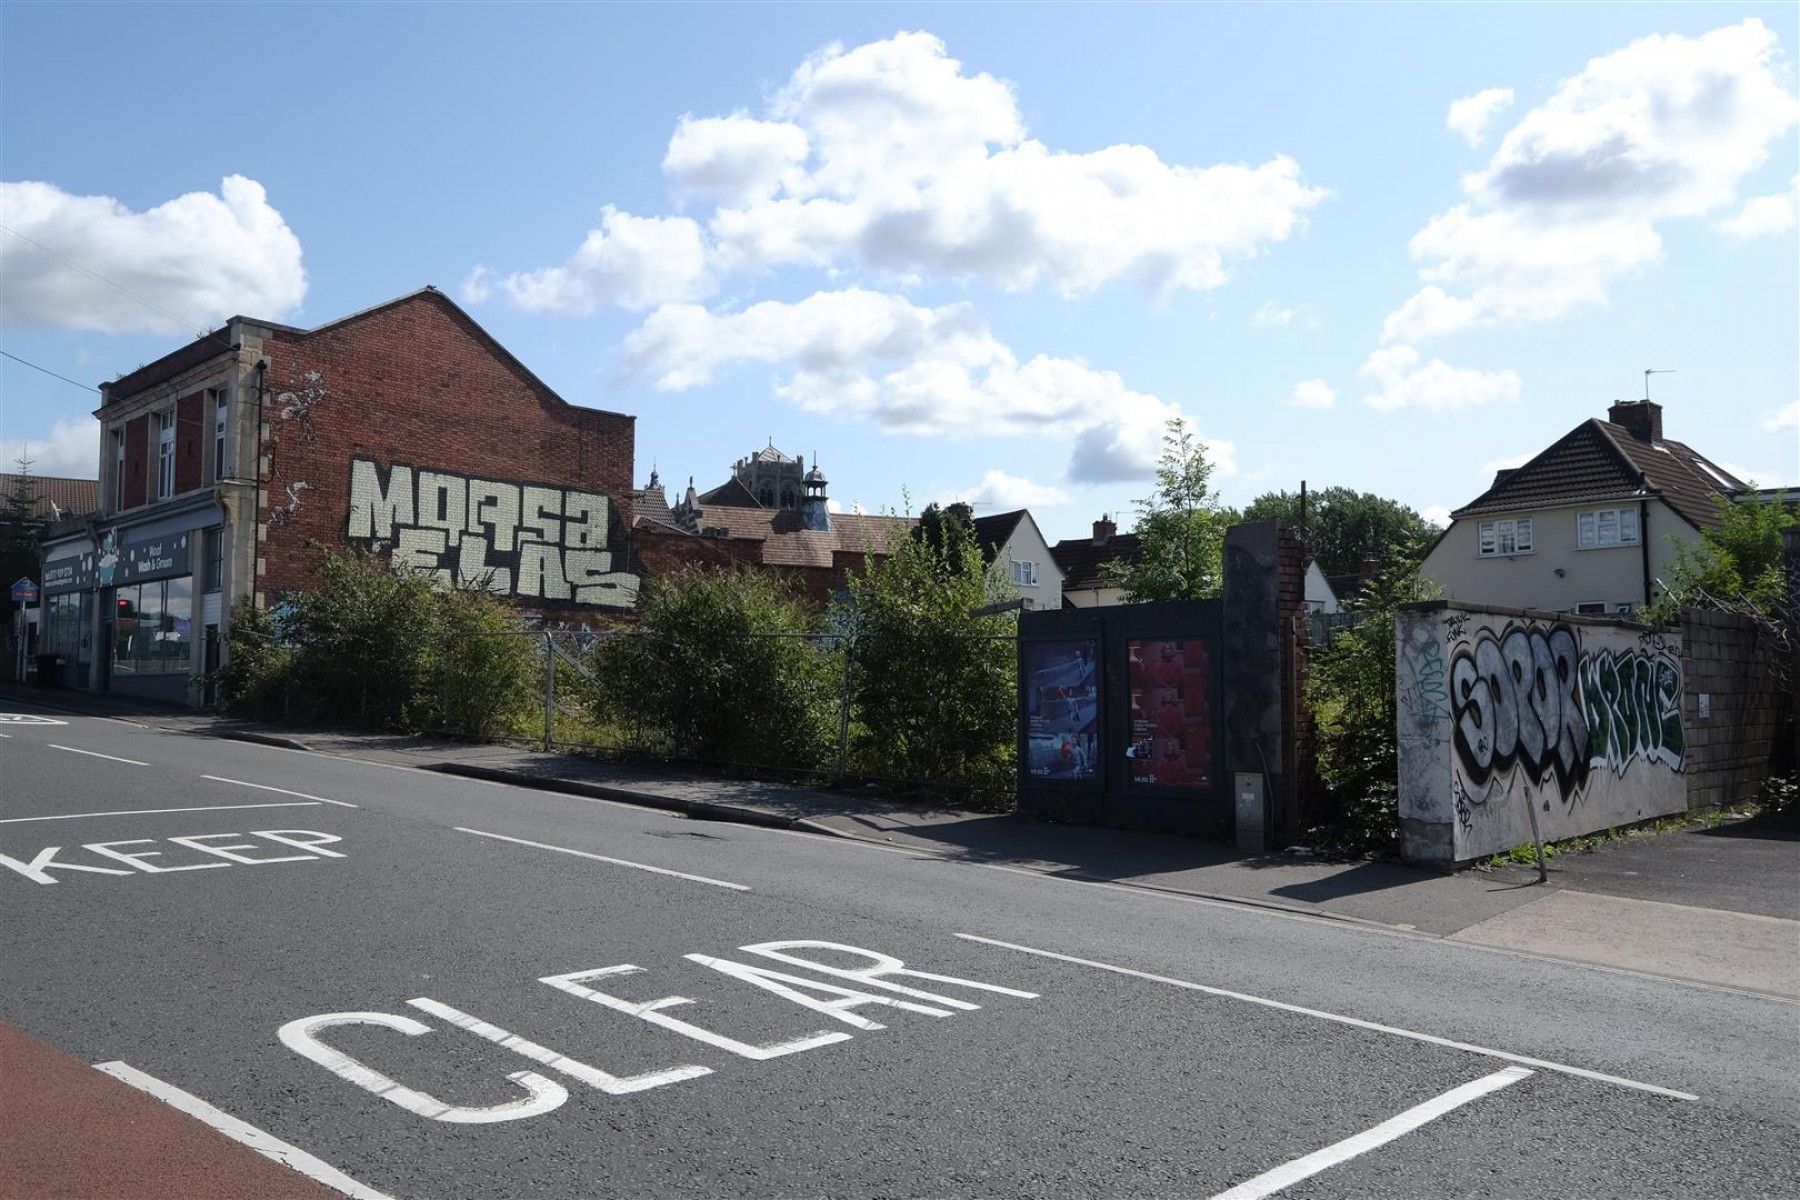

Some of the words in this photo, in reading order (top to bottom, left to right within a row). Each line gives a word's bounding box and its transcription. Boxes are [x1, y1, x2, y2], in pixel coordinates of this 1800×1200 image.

[138, 558, 151, 573] Wash
[157, 557, 173, 570] Groom
[149, 543, 162, 558] Woof
[0, 829, 348, 885] KEEP
[277, 939, 1041, 1124] CLEAR
